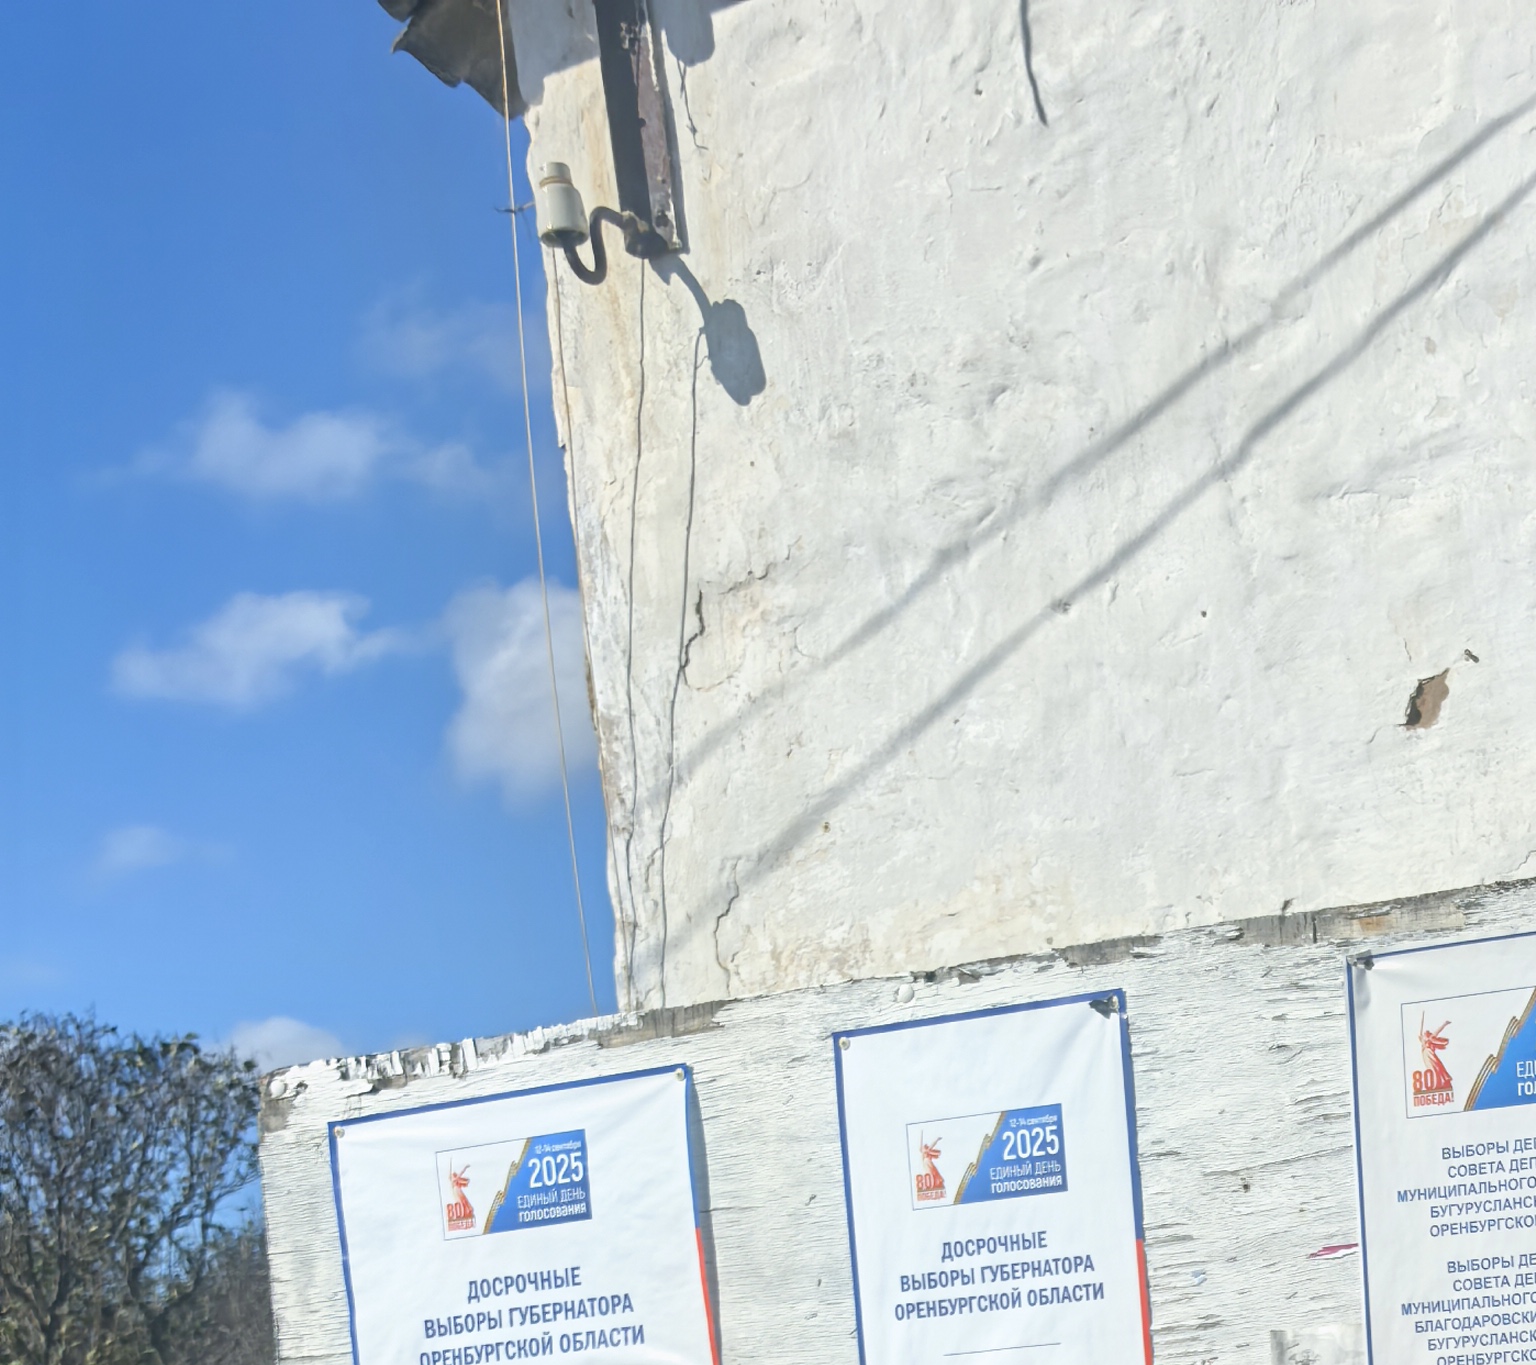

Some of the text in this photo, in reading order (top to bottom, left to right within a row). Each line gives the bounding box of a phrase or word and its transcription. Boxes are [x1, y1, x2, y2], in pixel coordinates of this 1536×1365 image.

[1413, 1069, 1435, 1092] 80
[1414, 1092, 1454, 1107] ПОБЕДА!
[1002, 1126, 1059, 1160] 2025
[1442, 1140, 1509, 1160] ВЫБОРЫ
[528, 1152, 583, 1188] 2025
[990, 1160, 1061, 1180] ЕДИНЫЙ ДЕНЬ
[1448, 1160, 1505, 1178] СОВЕТА
[517, 1187, 585, 1209] ЕДИНЫЙ ДЕНЬ
[1398, 1176, 1536, 1202] МУНИЦИПАЛЬНОГО
[942, 1231, 1047, 1262] ДОСРОЧНЫЕ
[900, 1255, 1094, 1292] ВЫБОРЫ ГУБЕРНАТОРА
[1448, 1255, 1514, 1274] ВЫБОРЫ
[468, 1266, 581, 1303] ДОСРОЧНЫЕ
[1453, 1275, 1510, 1292] СОВЕТА
[895, 1282, 1104, 1321] ОРЕНБУРГСКОЙ ОБЛАСТИ
[425, 1293, 634, 1339] ВЫБОРЫ ГУБЕРНАТОРА
[559, 1325, 644, 1352] ОБЛАСТИ
